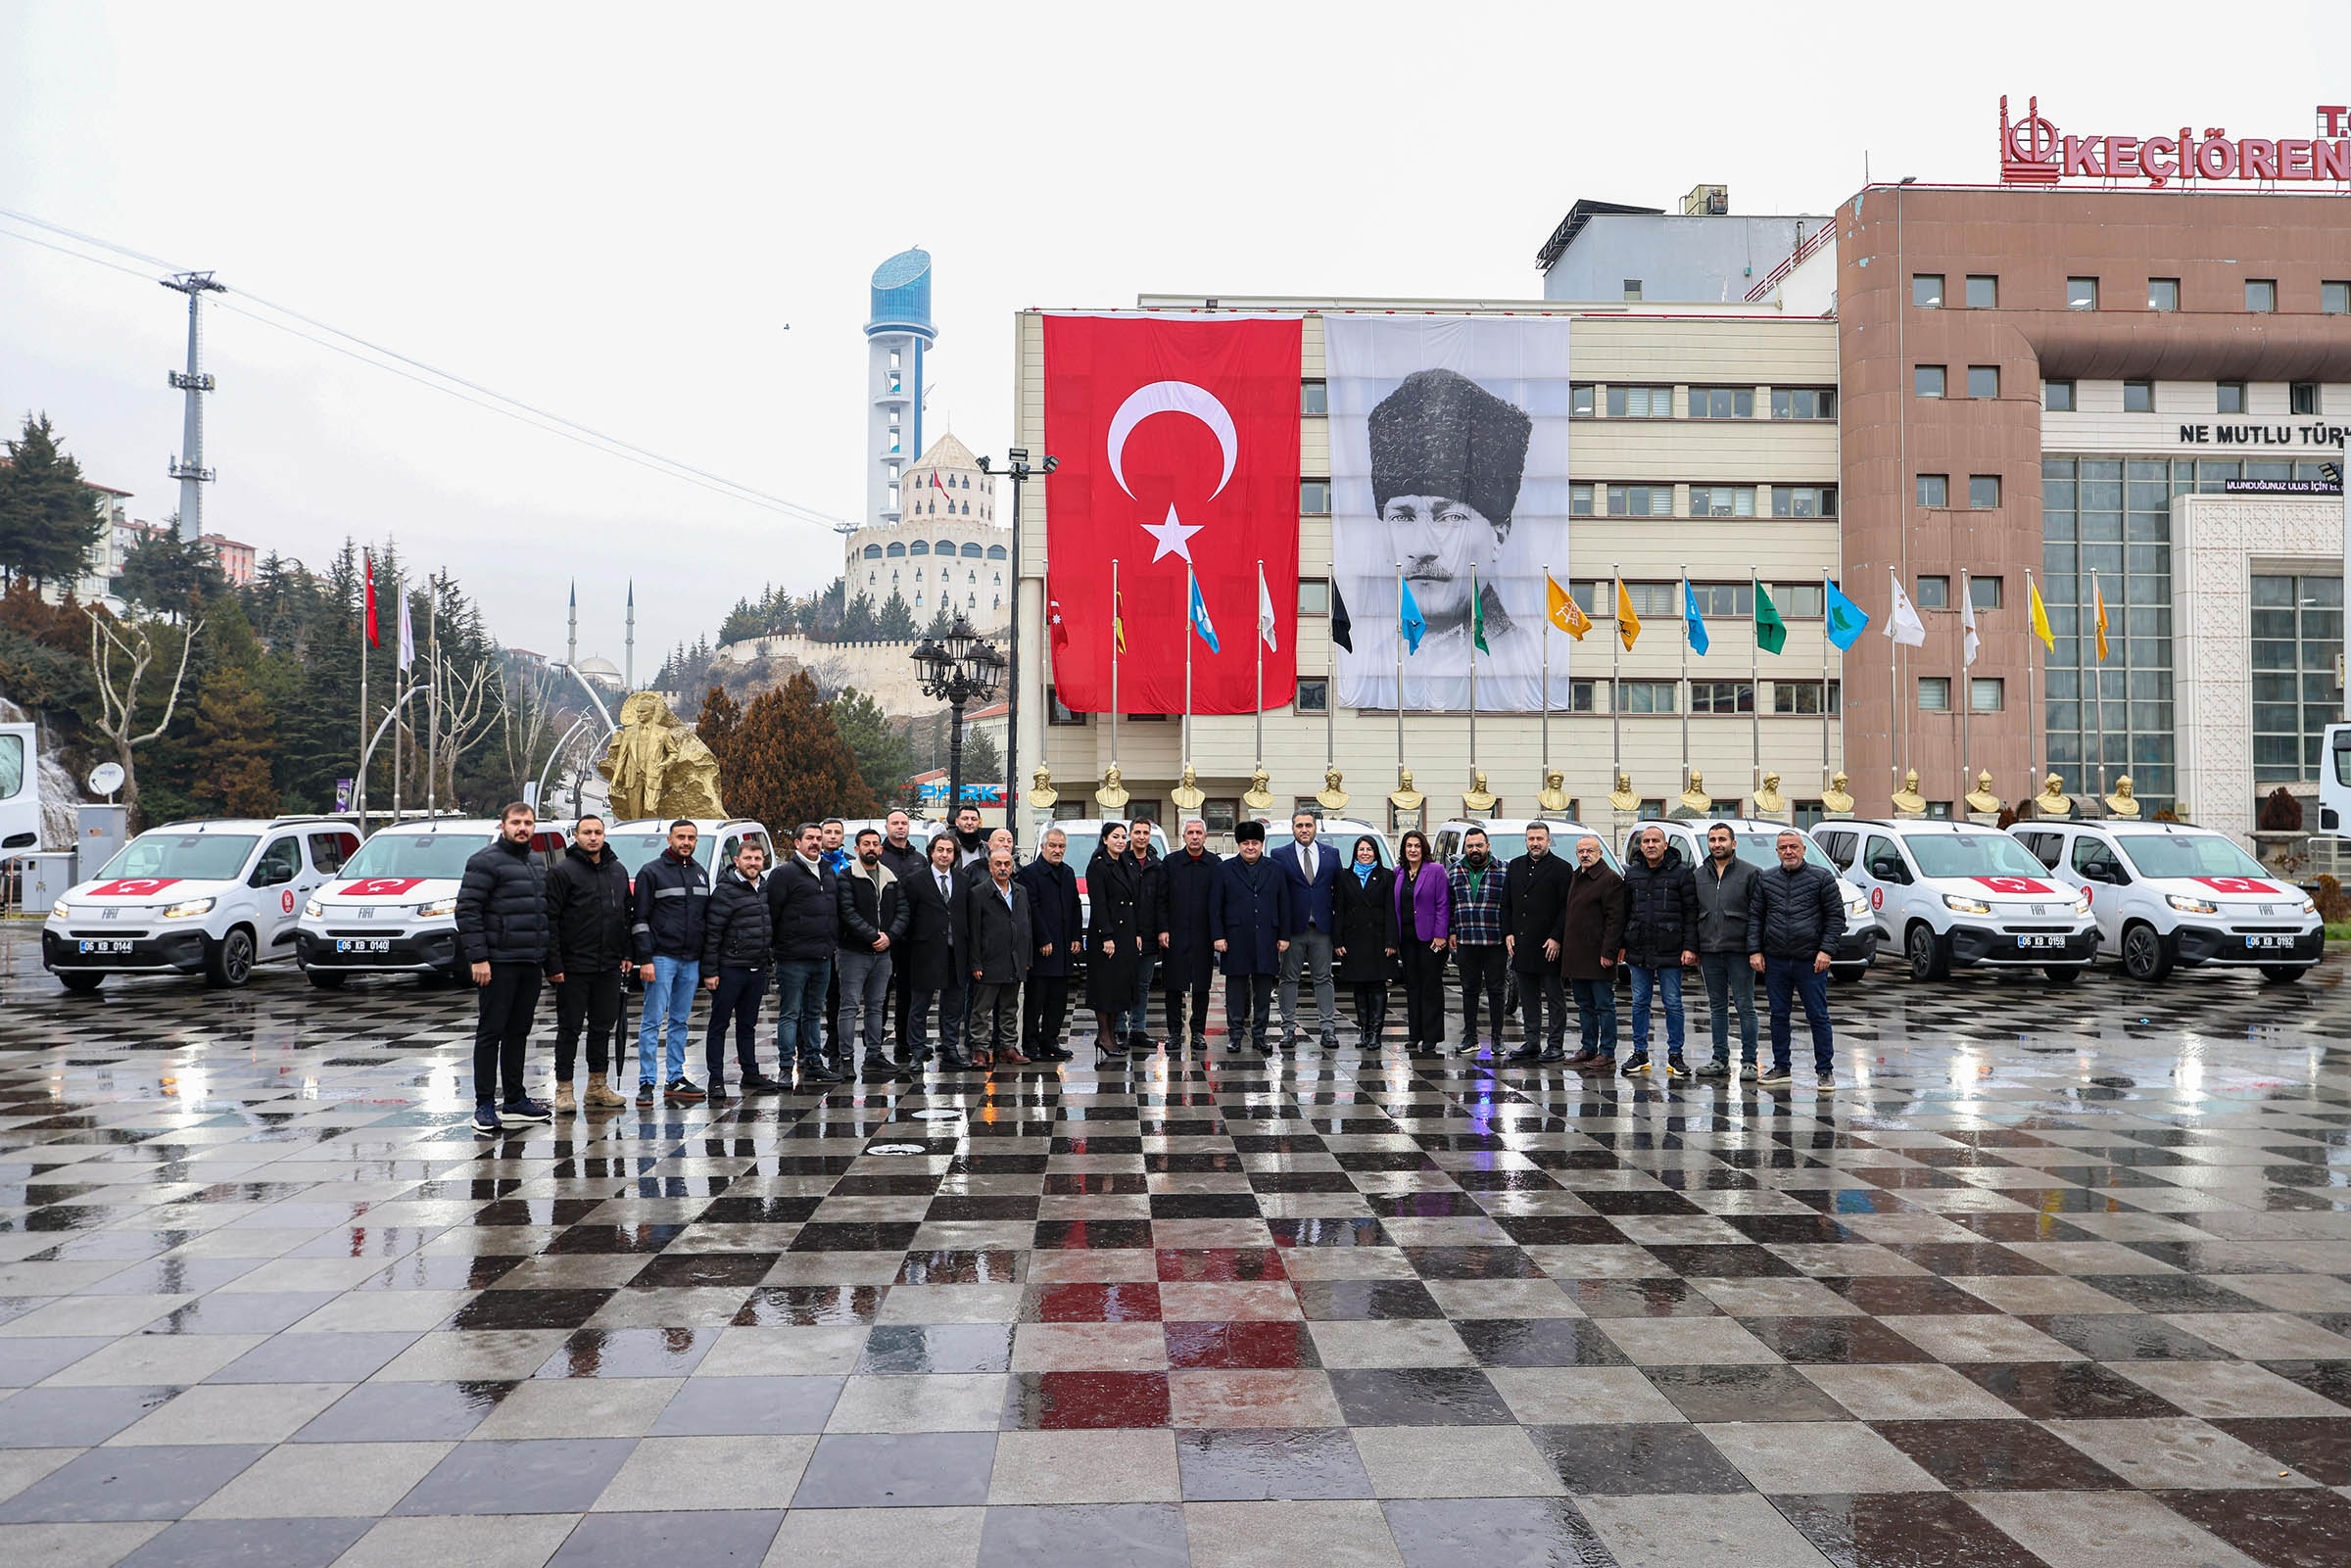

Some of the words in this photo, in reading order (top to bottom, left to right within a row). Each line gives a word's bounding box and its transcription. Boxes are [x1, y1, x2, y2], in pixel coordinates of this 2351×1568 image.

[2317, 106, 2351, 137] T.
[2063, 127, 2351, 188] KEÇİÖREN
[2181, 425, 2209, 443] NE
[2217, 426, 2291, 444] MUTLU
[102, 908, 120, 920] FIAT
[358, 907, 375, 919] FIAT
[2030, 904, 2046, 916] FIAT
[2258, 905, 2275, 916] FIAT
[342, 940, 352, 950] 06
[355, 940, 365, 950] KB
[370, 940, 388, 950] 0140
